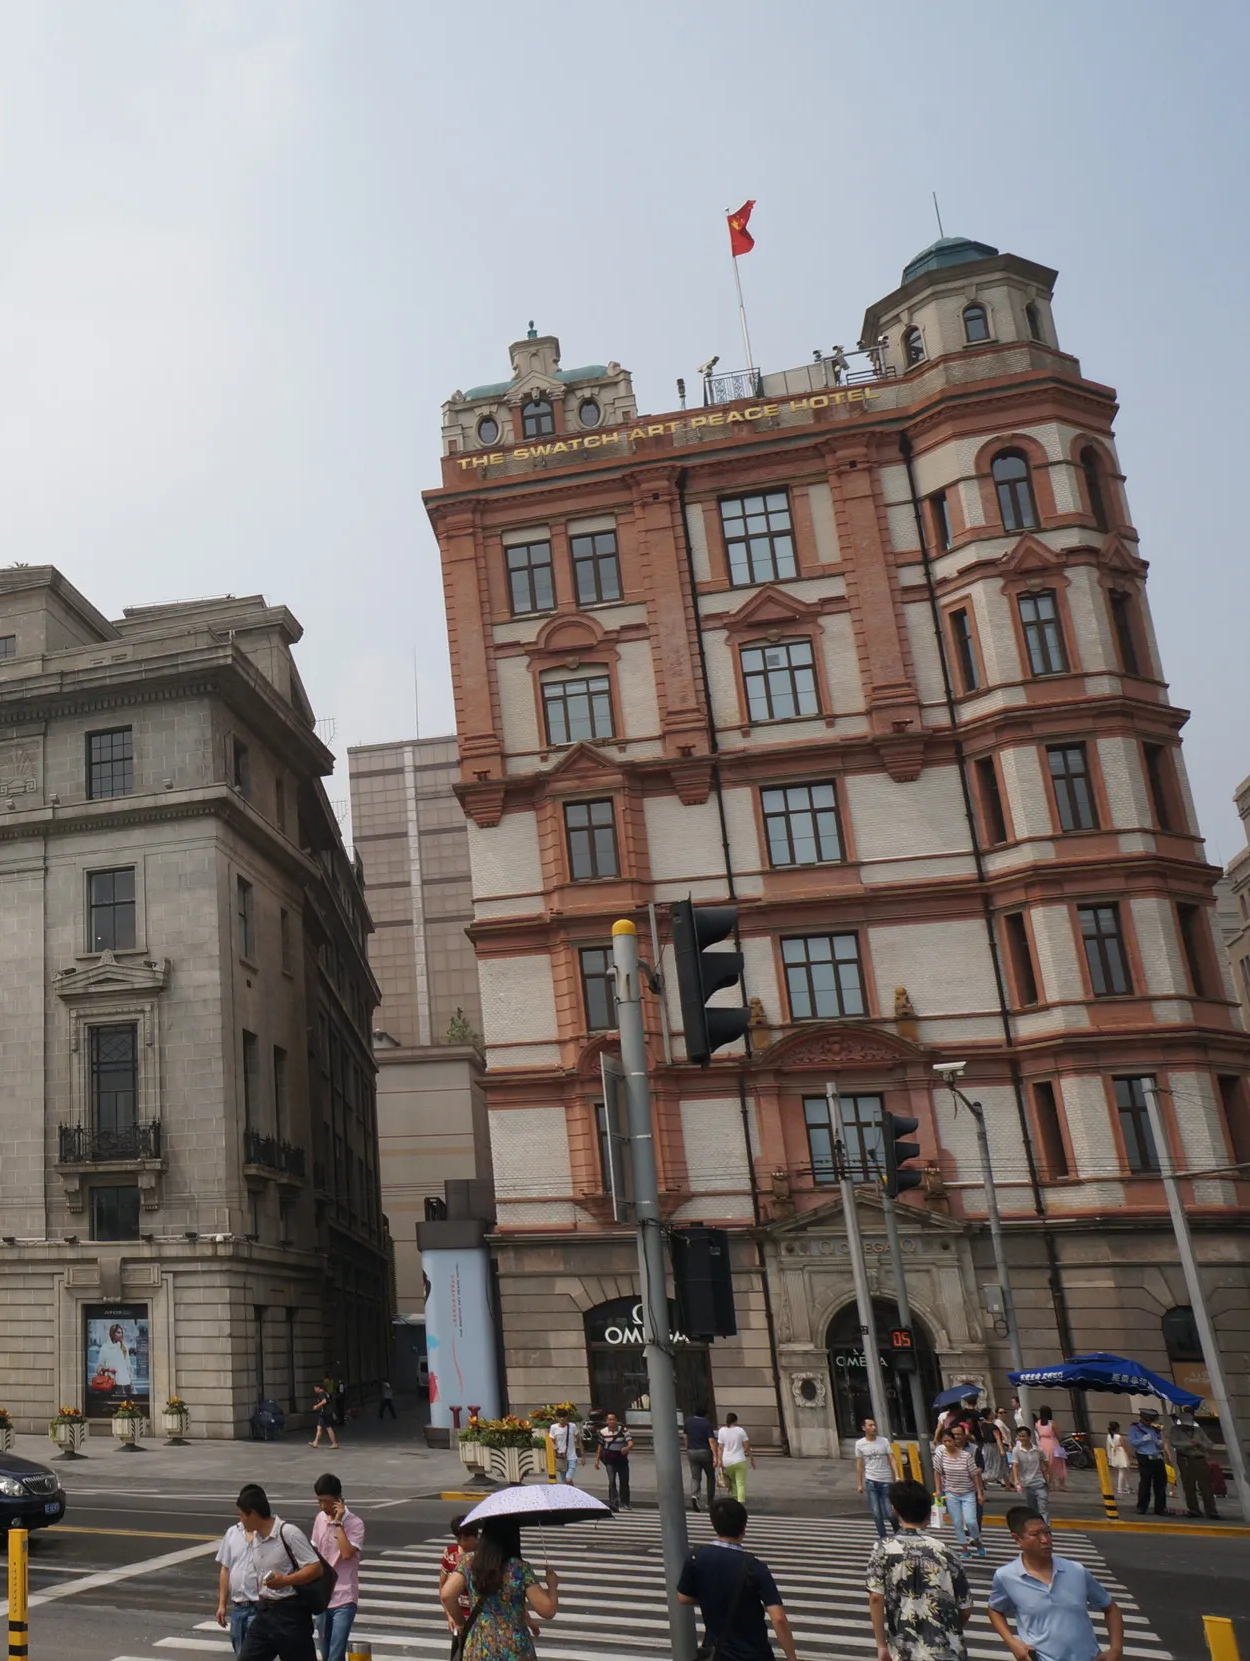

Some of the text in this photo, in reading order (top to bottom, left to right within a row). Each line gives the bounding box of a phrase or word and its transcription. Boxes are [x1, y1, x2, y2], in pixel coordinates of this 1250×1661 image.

[457, 387, 880, 470] THE SWATCH ART PEACE HOTEL
[839, 1242, 892, 1252] OEGA
[604, 1326, 691, 1345] OMA
[893, 1331, 911, 1347] 05
[836, 1356, 889, 1367] OMEA
